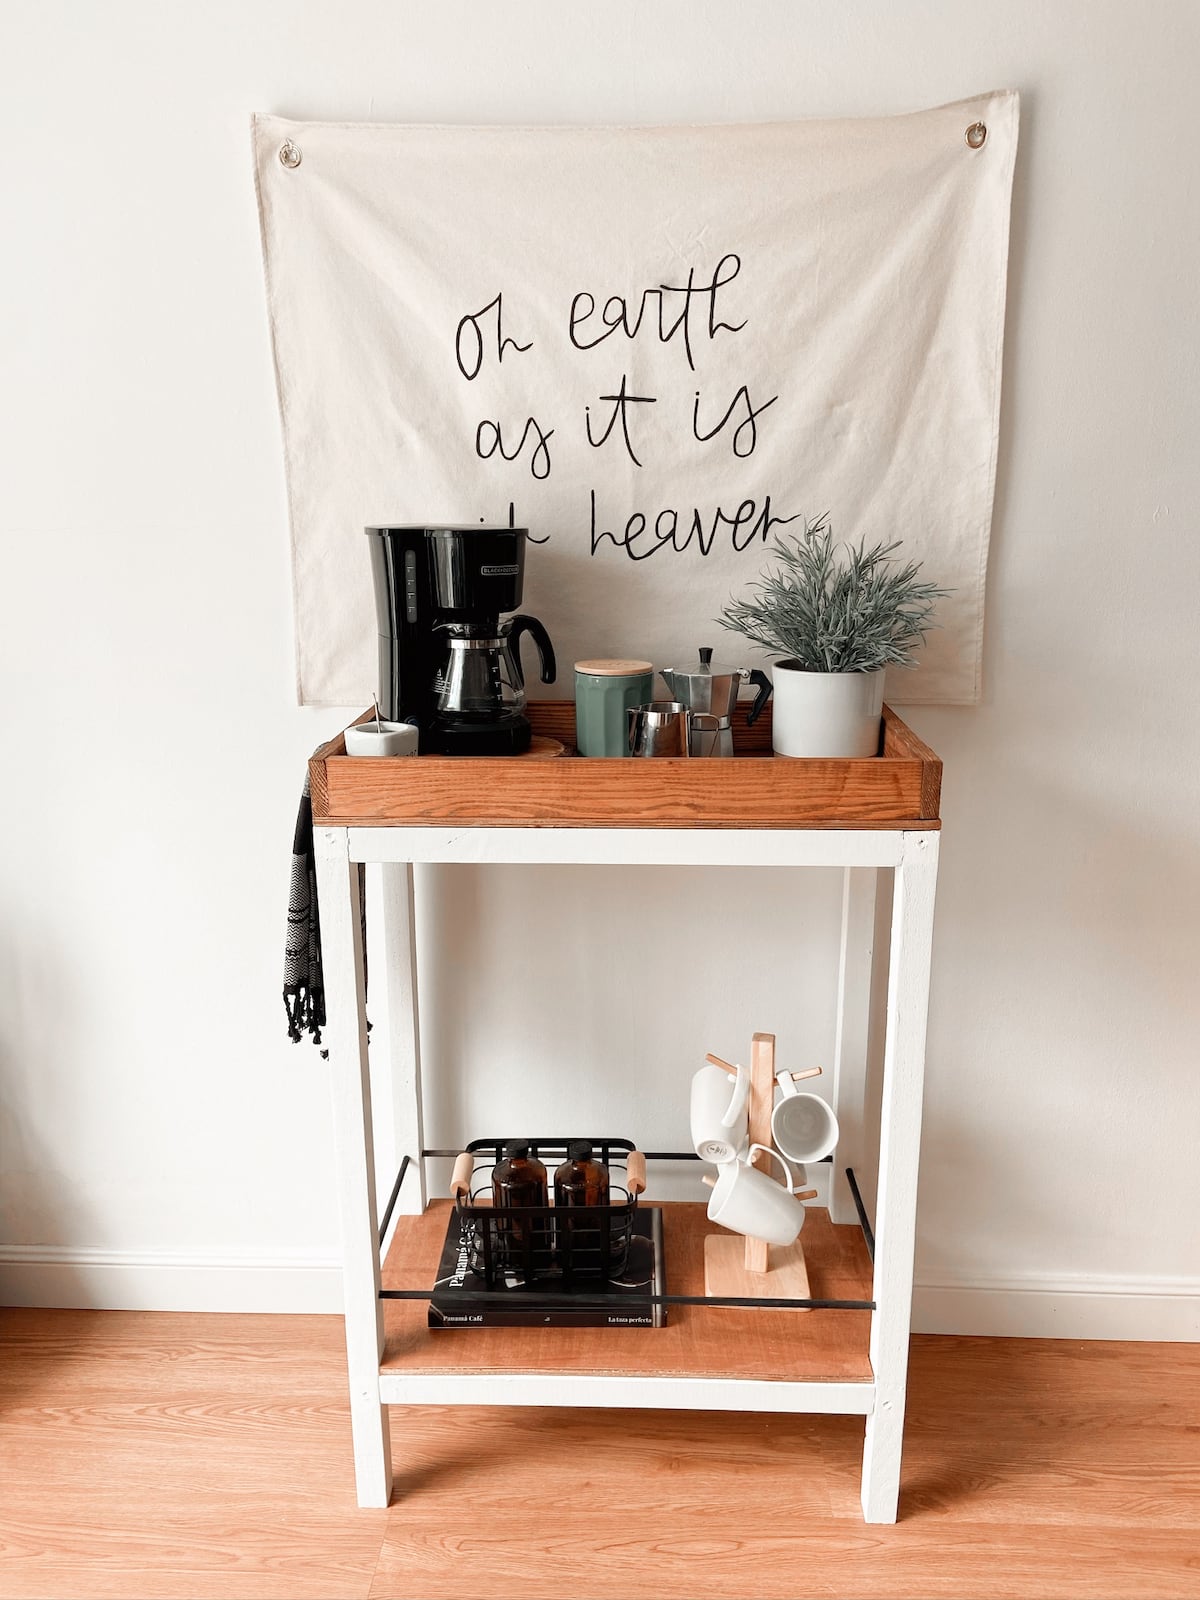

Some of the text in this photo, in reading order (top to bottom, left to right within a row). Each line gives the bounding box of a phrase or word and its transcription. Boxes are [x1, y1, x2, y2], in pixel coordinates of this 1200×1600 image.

[570, 254, 748, 371] earth
[476, 374, 778, 480] as it is
